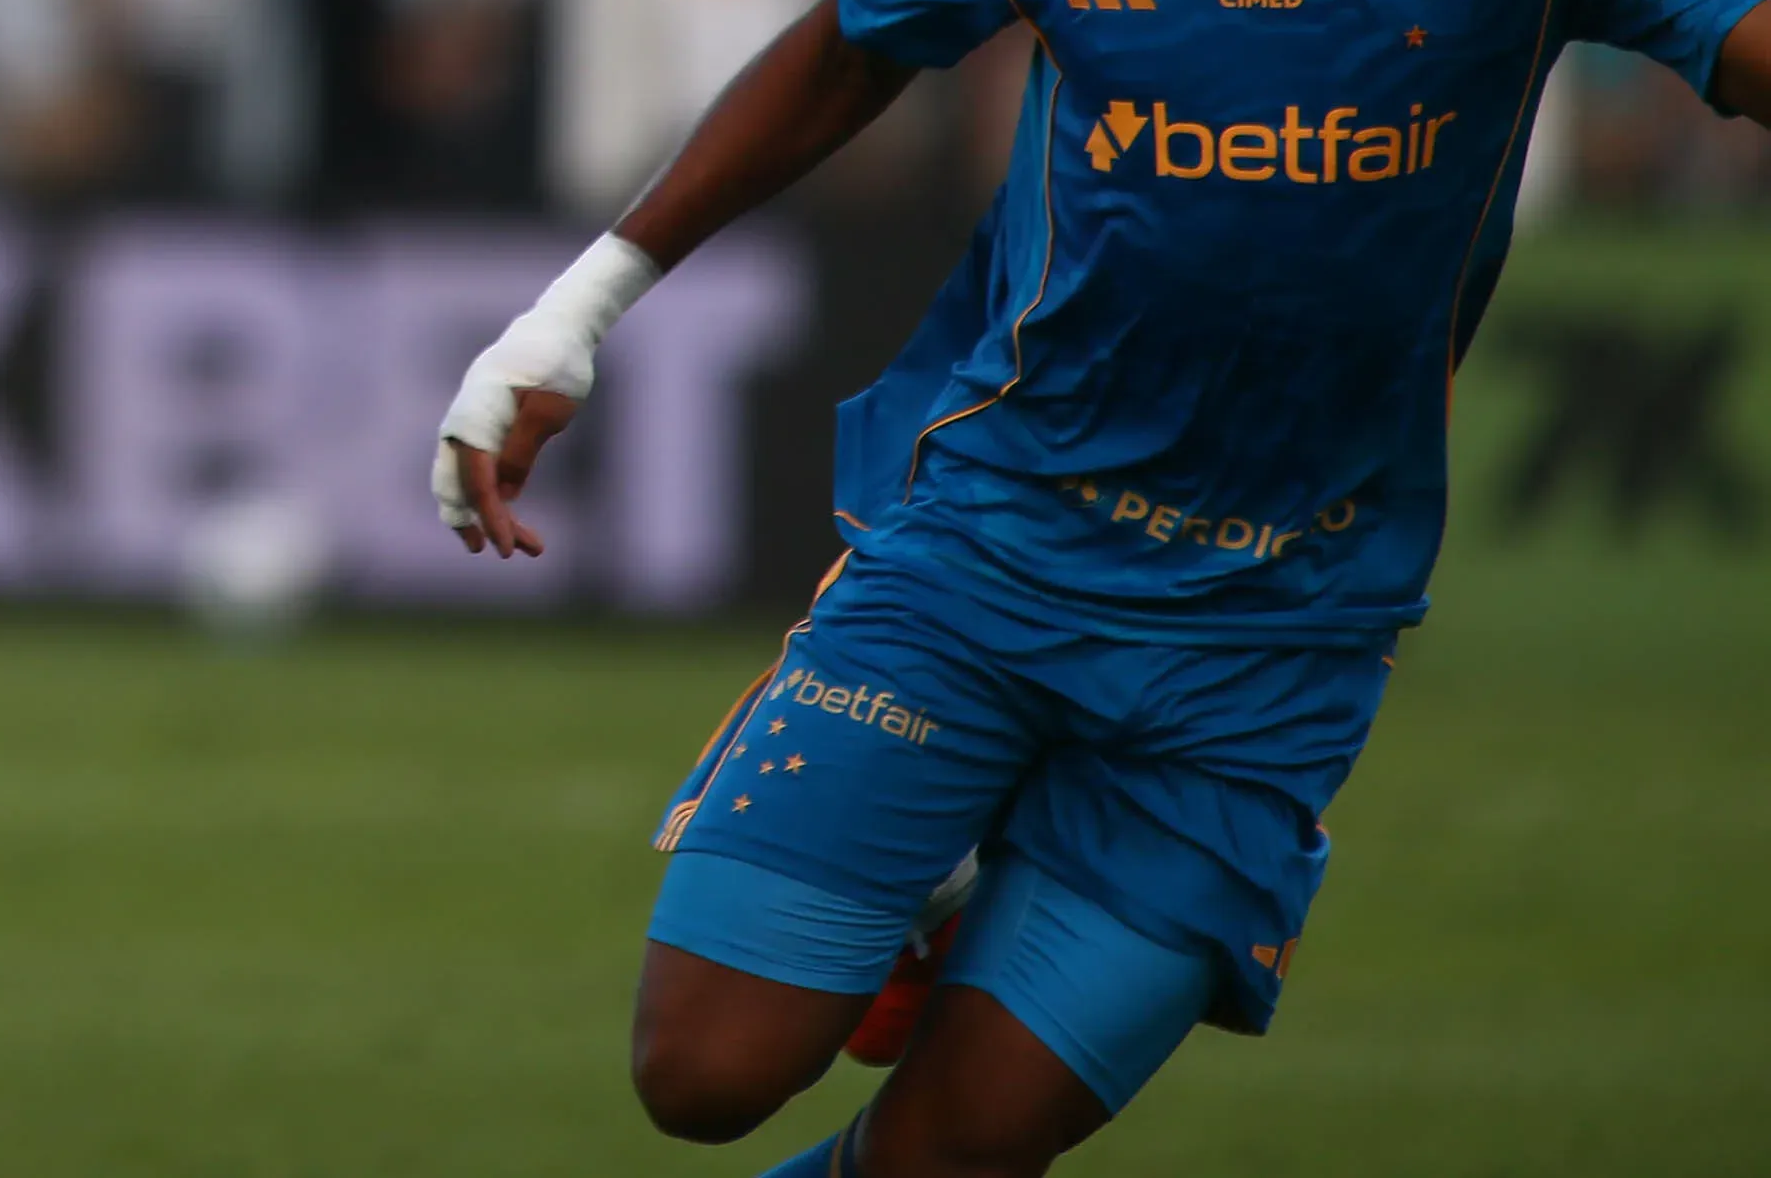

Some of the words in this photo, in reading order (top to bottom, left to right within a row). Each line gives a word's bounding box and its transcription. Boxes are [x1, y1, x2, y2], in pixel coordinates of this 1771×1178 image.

[1152, 101, 1458, 184] betfair
[1111, 489, 1356, 559] PERDIO
[793, 670, 941, 745] betfair
